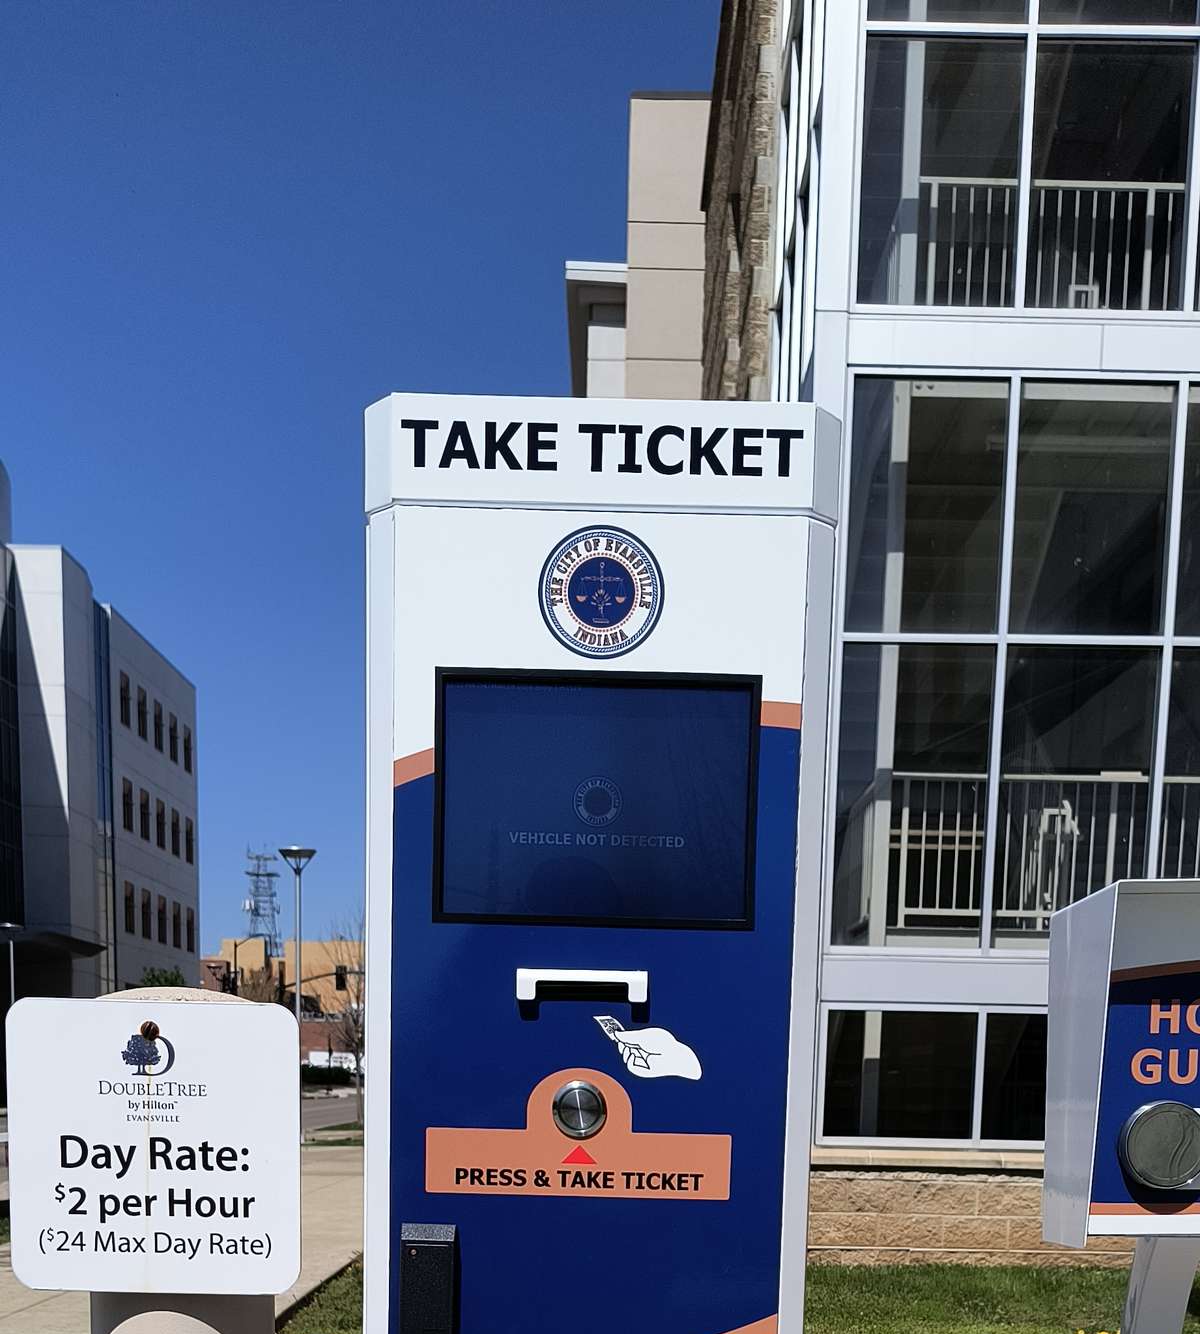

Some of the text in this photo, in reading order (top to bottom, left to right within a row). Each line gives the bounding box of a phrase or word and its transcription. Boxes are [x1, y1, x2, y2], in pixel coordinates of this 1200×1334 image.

[401, 420, 804, 477] TAKE TICKET
[550, 538, 653, 609] THE CITY OF EVANSVILLE
[573, 626, 628, 646] INDIANA
[509, 831, 685, 848] VEHICLE NOT DETECTED
[127, 1114, 180, 1122] EVANSVILLE
[128, 1100, 139, 1111] by
[60, 1135, 249, 1179] Day Rate:
[454, 1168, 704, 1191] PRESS & TAKE TICKET
[55, 1183, 255, 1223] $2 per Hour
[39, 1227, 272, 1260] ($24 Max Day Rate)
